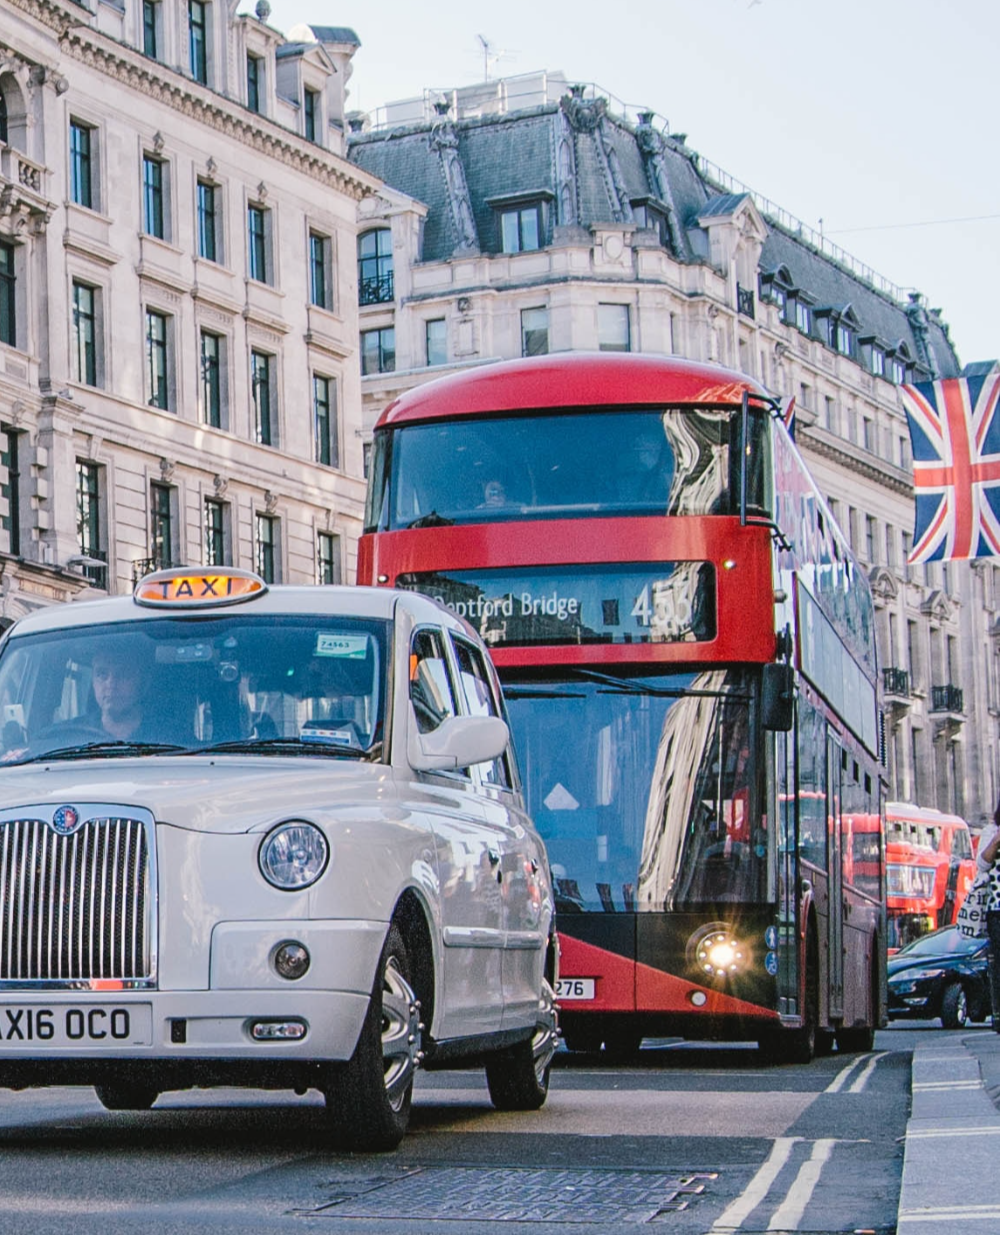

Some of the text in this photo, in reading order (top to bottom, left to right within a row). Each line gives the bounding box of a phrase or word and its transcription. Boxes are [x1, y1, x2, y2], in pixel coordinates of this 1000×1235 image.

[159, 577, 232, 600] TAXI
[521, 591, 578, 620] Bridge
[556, 980, 584, 996] 276
[65, 1009, 130, 1039] OCO
